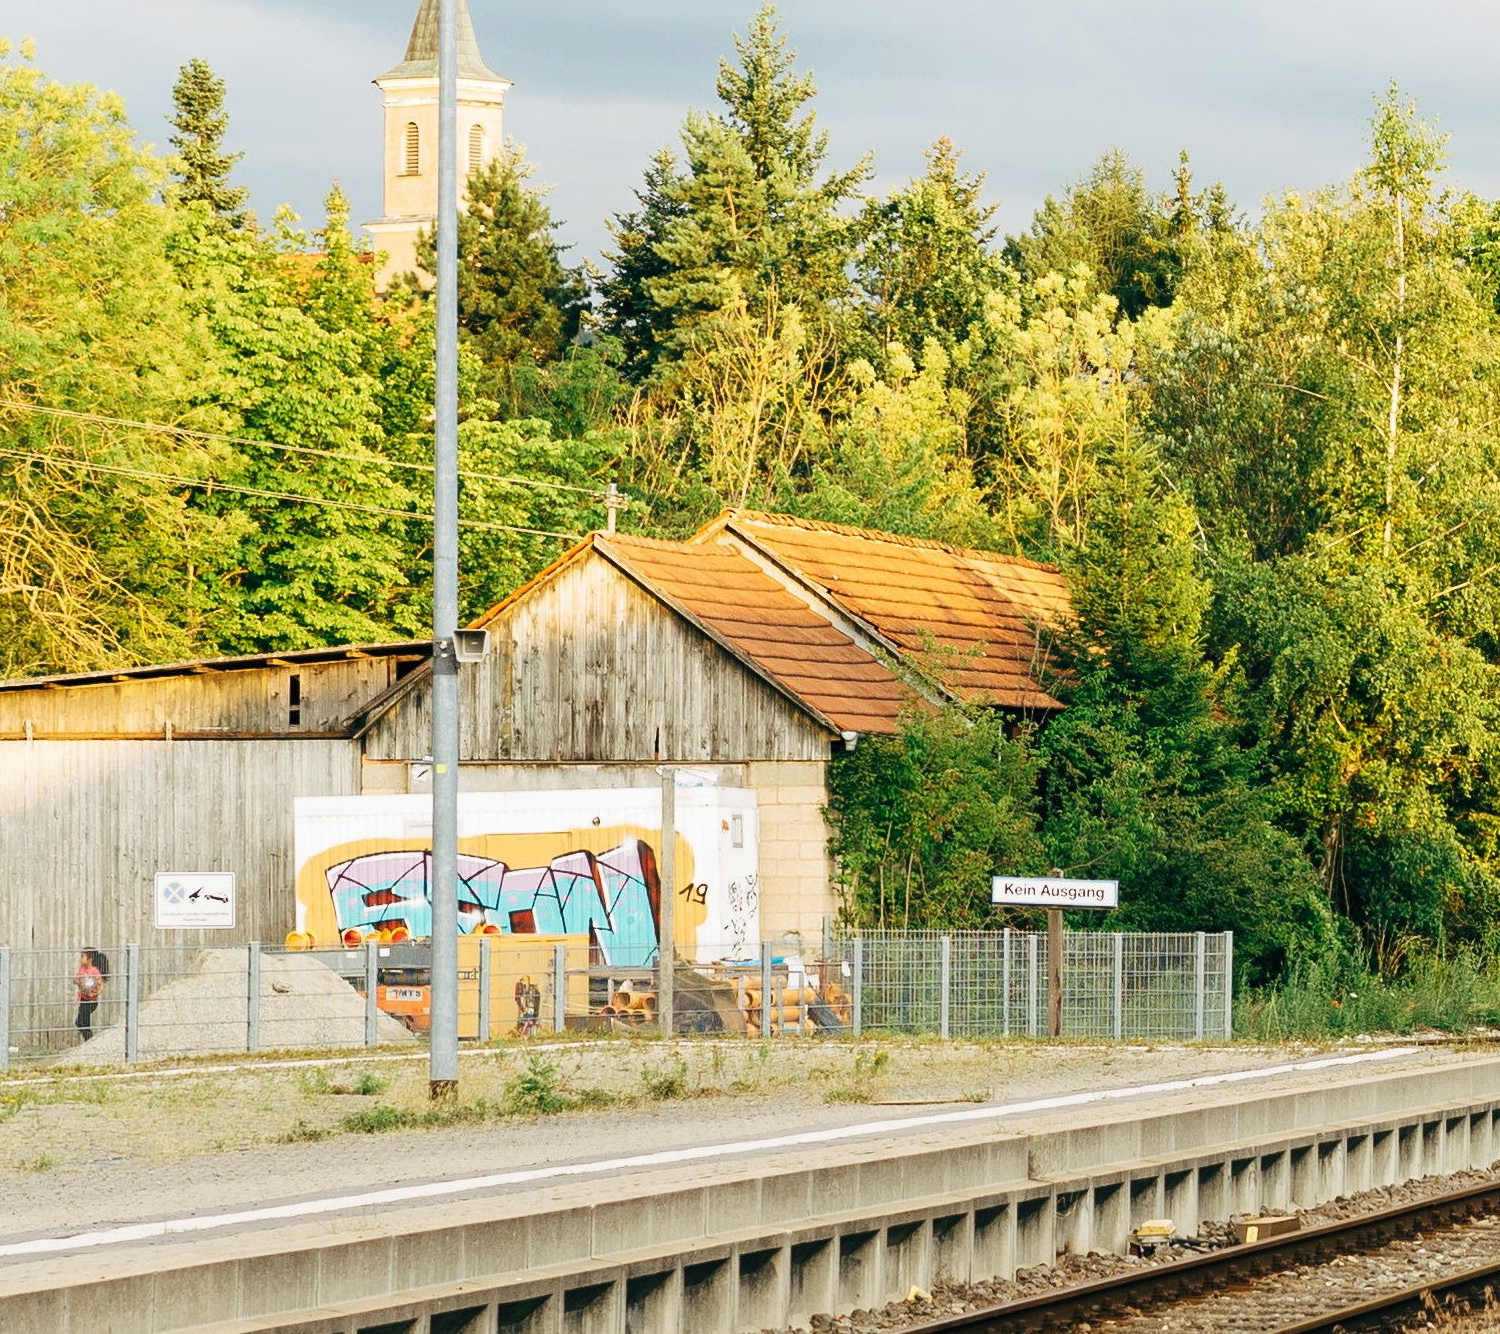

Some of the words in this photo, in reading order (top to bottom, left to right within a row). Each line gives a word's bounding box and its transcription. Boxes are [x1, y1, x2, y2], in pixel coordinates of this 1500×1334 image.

[678, 882, 708, 905] 19
[1004, 883, 1036, 896] Kein
[1040, 884, 1105, 901] Ausgang
